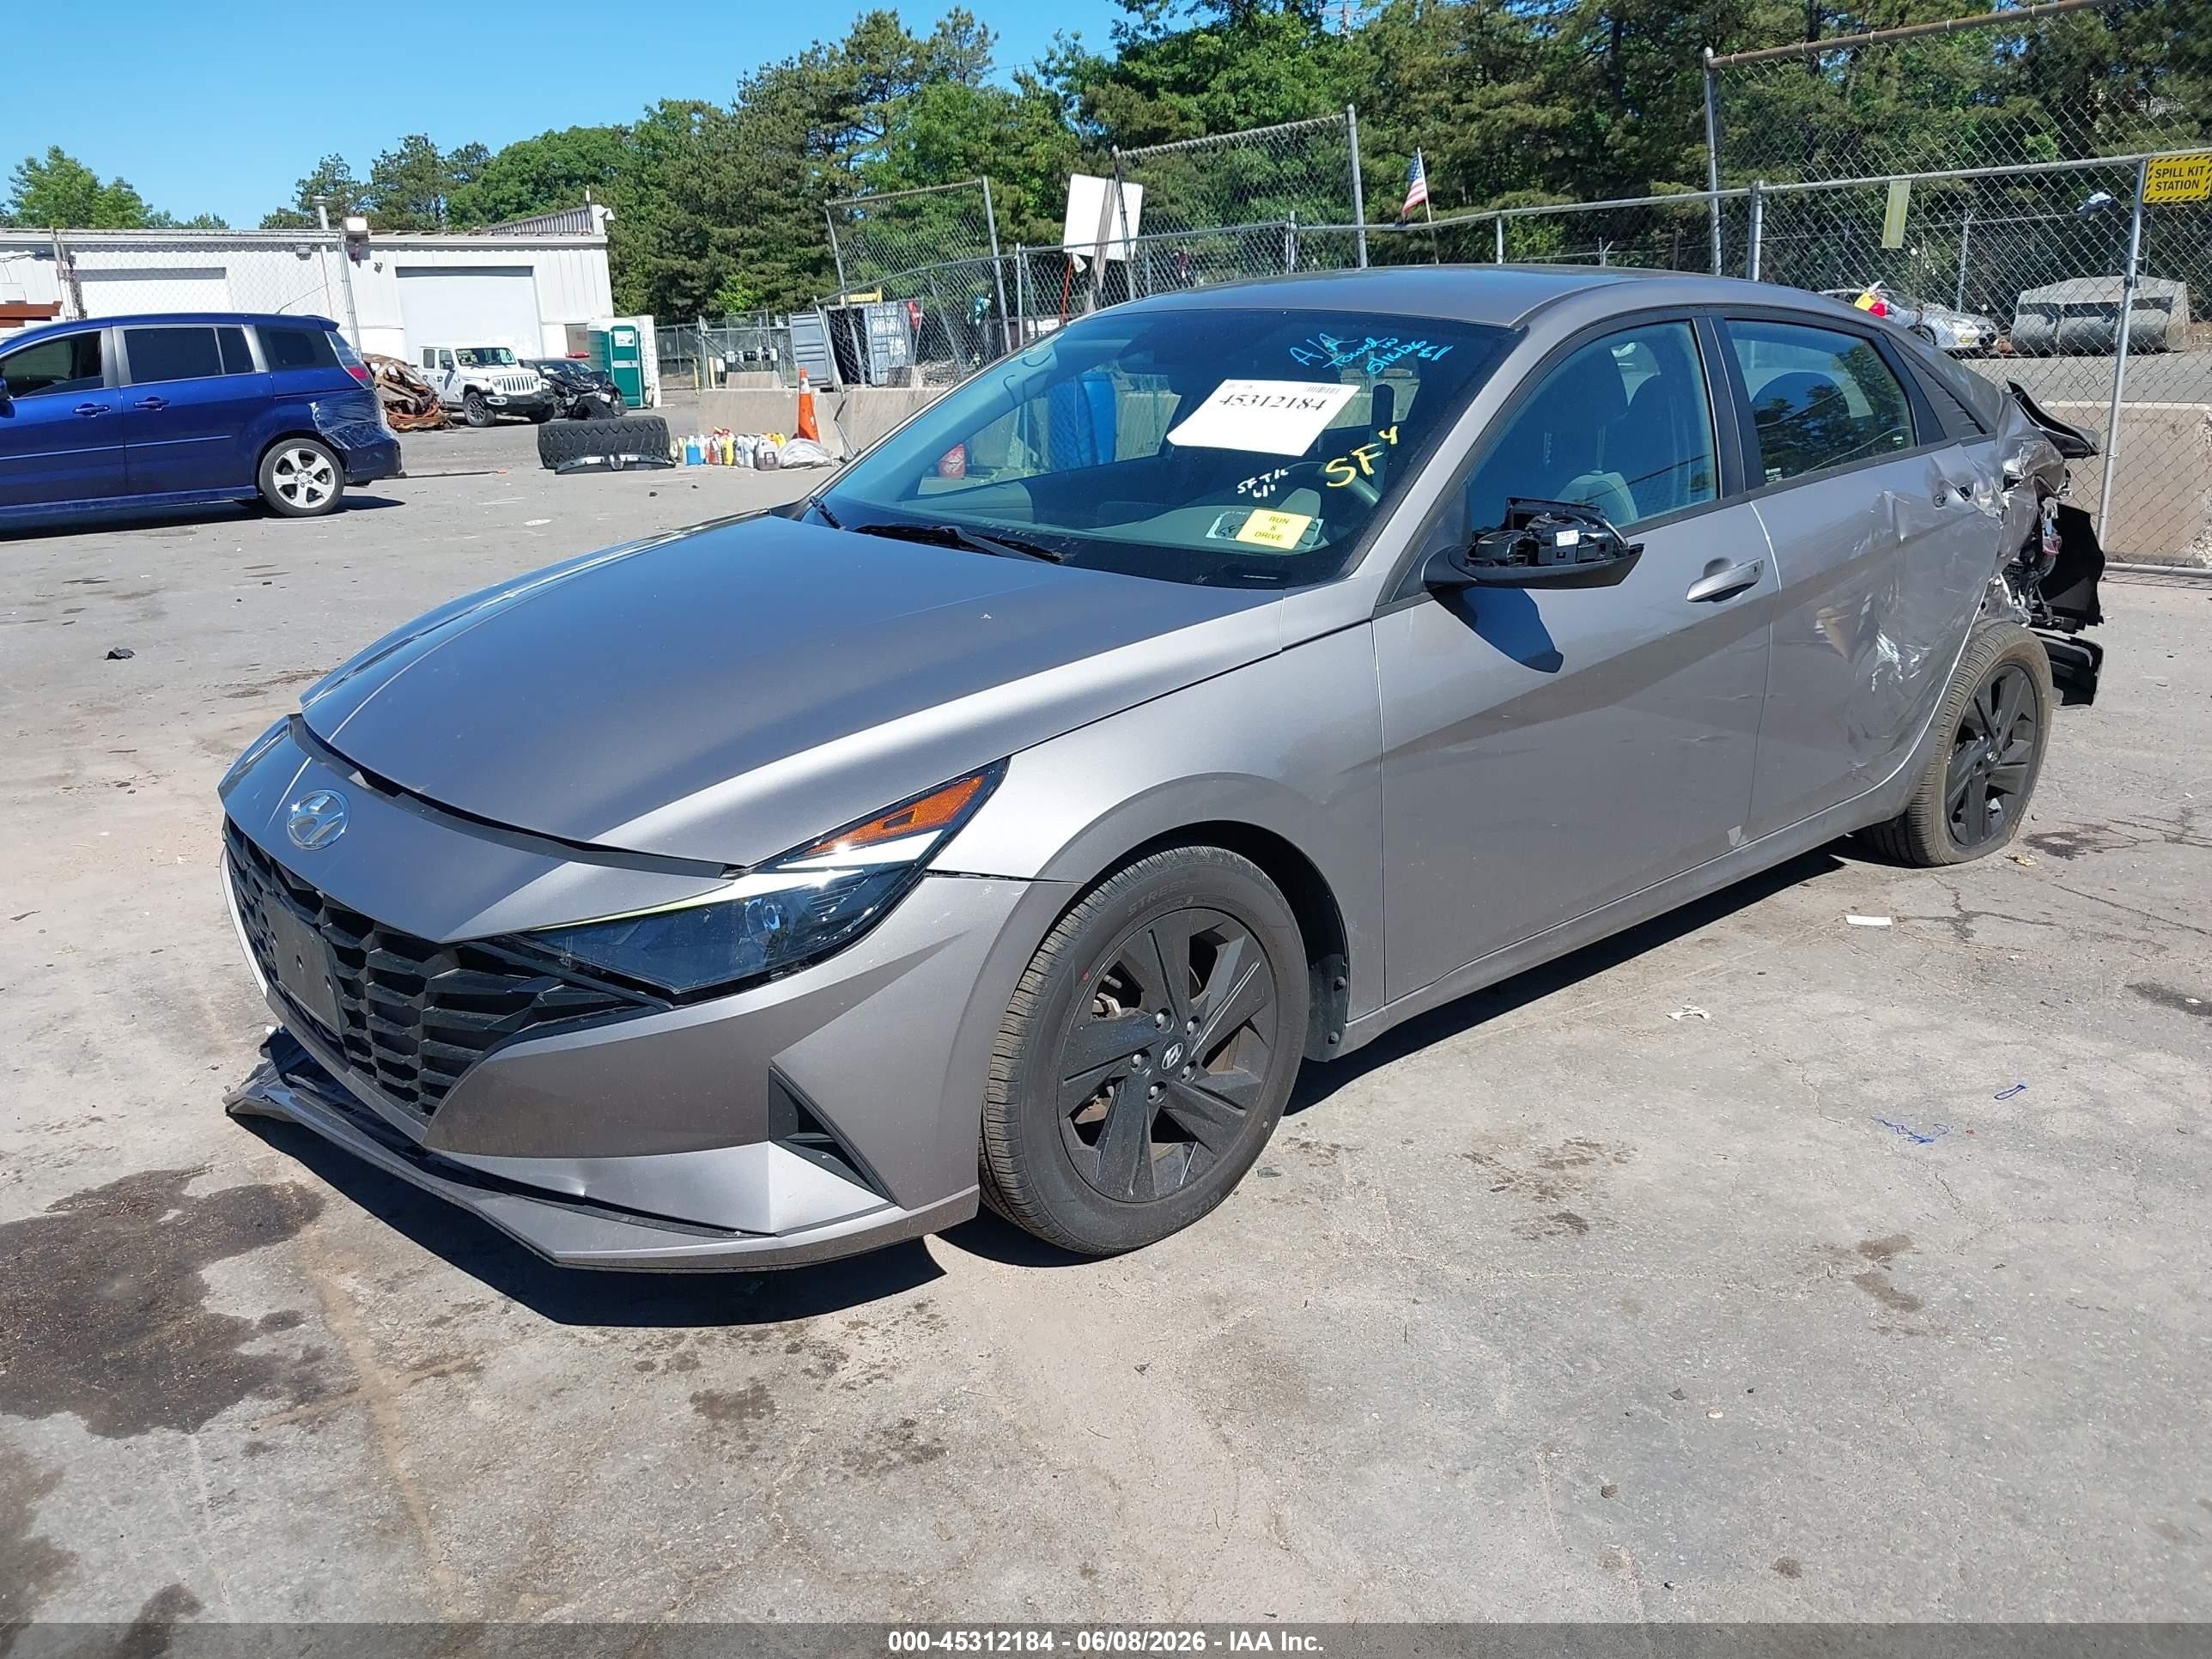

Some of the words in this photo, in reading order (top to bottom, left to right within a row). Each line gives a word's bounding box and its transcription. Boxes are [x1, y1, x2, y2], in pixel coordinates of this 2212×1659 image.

[2154, 167, 2185, 179] SPILL
[2187, 166, 2205, 176] KIT
[2155, 179, 2200, 191] STATION
[1218, 393, 1328, 411] 45312184
[1255, 531, 1284, 541] DRIVE
